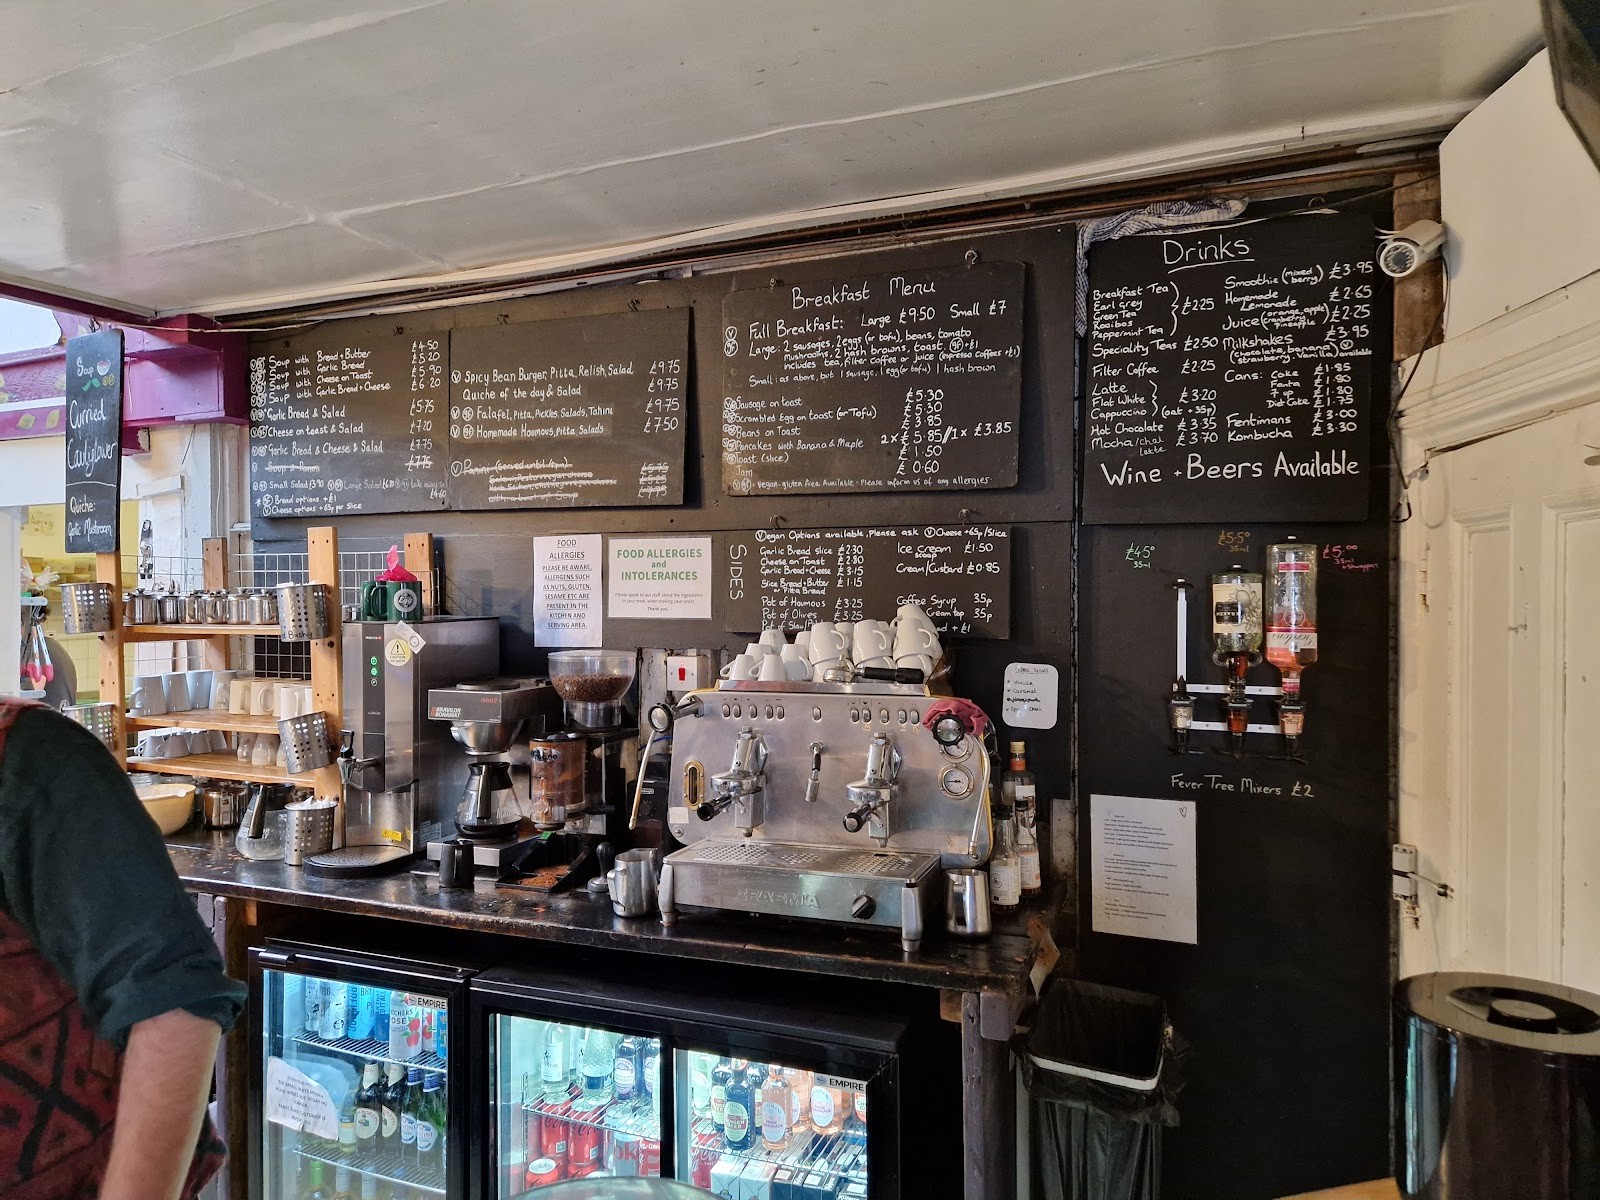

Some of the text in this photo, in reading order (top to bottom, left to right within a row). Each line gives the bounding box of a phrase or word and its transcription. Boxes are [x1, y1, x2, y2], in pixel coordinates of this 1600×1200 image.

[1163, 234, 1250, 265] Drinks
[1329, 262, 1373, 280] £3.95
[1224, 276, 1279, 289] Smoothie
[792, 277, 936, 309] Breakfast Menu
[1093, 283, 1169, 300] Breakfast Tea
[1225, 286, 1372, 305] Homemade £2.65
[1094, 301, 1115, 312] Earl
[1241, 297, 1297, 311] Lemonade
[749, 300, 1006, 340] Full Breakfast: Large £9.50 Small £7
[1093, 310, 1137, 321] Green Tea
[1222, 304, 1370, 331] Juice £2.25
[1093, 320, 1133, 329] Rooibos
[783, 341, 790, 351] 2
[938, 327, 971, 338] tomato
[1092, 325, 1163, 341] Peppermint Tea
[1222, 326, 1369, 351] Milkshakes £3.95
[844, 347, 866, 357] hash
[1093, 335, 1219, 356] Speciality Teas £2.50
[77, 356, 94, 377] Soup
[268, 356, 290, 368] Soup
[649, 360, 680, 375] £9.75
[784, 351, 934, 370] includes coffee juice
[268, 370, 290, 381] Soup
[341, 361, 365, 370] Bread
[465, 362, 633, 386] Spicy Bean Salad
[820, 363, 996, 379] but hash brown
[1092, 362, 1159, 379] Filter Coffee
[1271, 370, 1299, 379] Coke
[317, 372, 373, 384] Cheese Toast
[1270, 380, 1300, 388] Fanta
[647, 378, 679, 393] £9.75
[1091, 383, 1128, 396] Latte
[463, 384, 581, 402] Quiche of the day & Salad
[736, 396, 803, 411] Sausage on toast
[1092, 394, 1146, 408] Flat White
[1266, 397, 1310, 408] Diet Coke
[69, 400, 107, 429] Curried
[267, 405, 346, 420] Garlic Bread Salad
[588, 406, 613, 416] Tahini
[779, 409, 834, 426] Egg on toast
[1090, 408, 1147, 422] Cappuccino
[1226, 412, 1291, 428] Fentimans
[268, 426, 294, 437] Cheese
[307, 426, 327, 434] toast
[338, 423, 363, 434] Salad
[476, 424, 604, 439] Homemade Salads
[736, 426, 801, 438] Beans on Toast
[1091, 421, 1164, 437] Hot Chocolate
[1227, 429, 1293, 443] Kombucha
[292, 440, 383, 456] Bread Cheese Salad
[735, 438, 864, 452] Pancakes with Banana Maple
[761, 452, 789, 464] (slice)
[1100, 449, 1359, 486] Wine Beers Available
[788, 529, 919, 542] Options ask
[557, 539, 576, 547] FOOD
[897, 542, 913, 554] Ice
[964, 542, 994, 554] £1.50
[617, 549, 702, 558] FOOD ALLERGIES
[759, 545, 832, 556] Garlic Bread slice
[760, 556, 825, 567] Cheese Toast
[966, 561, 1000, 575] £0.85
[621, 571, 698, 580] INTOLERANCES
[729, 544, 747, 600] SIDES
[783, 586, 826, 595] Pitta Bread
[761, 597, 826, 607] Pot of Houmous
[896, 593, 992, 608] Coffee Syrup 35p
[791, 609, 817, 619] Olives
[1171, 773, 1314, 797] Fever Tree Mixers £2
[417, 998, 446, 1009] EMPIRE
[829, 1078, 864, 1091] EMPIRE
